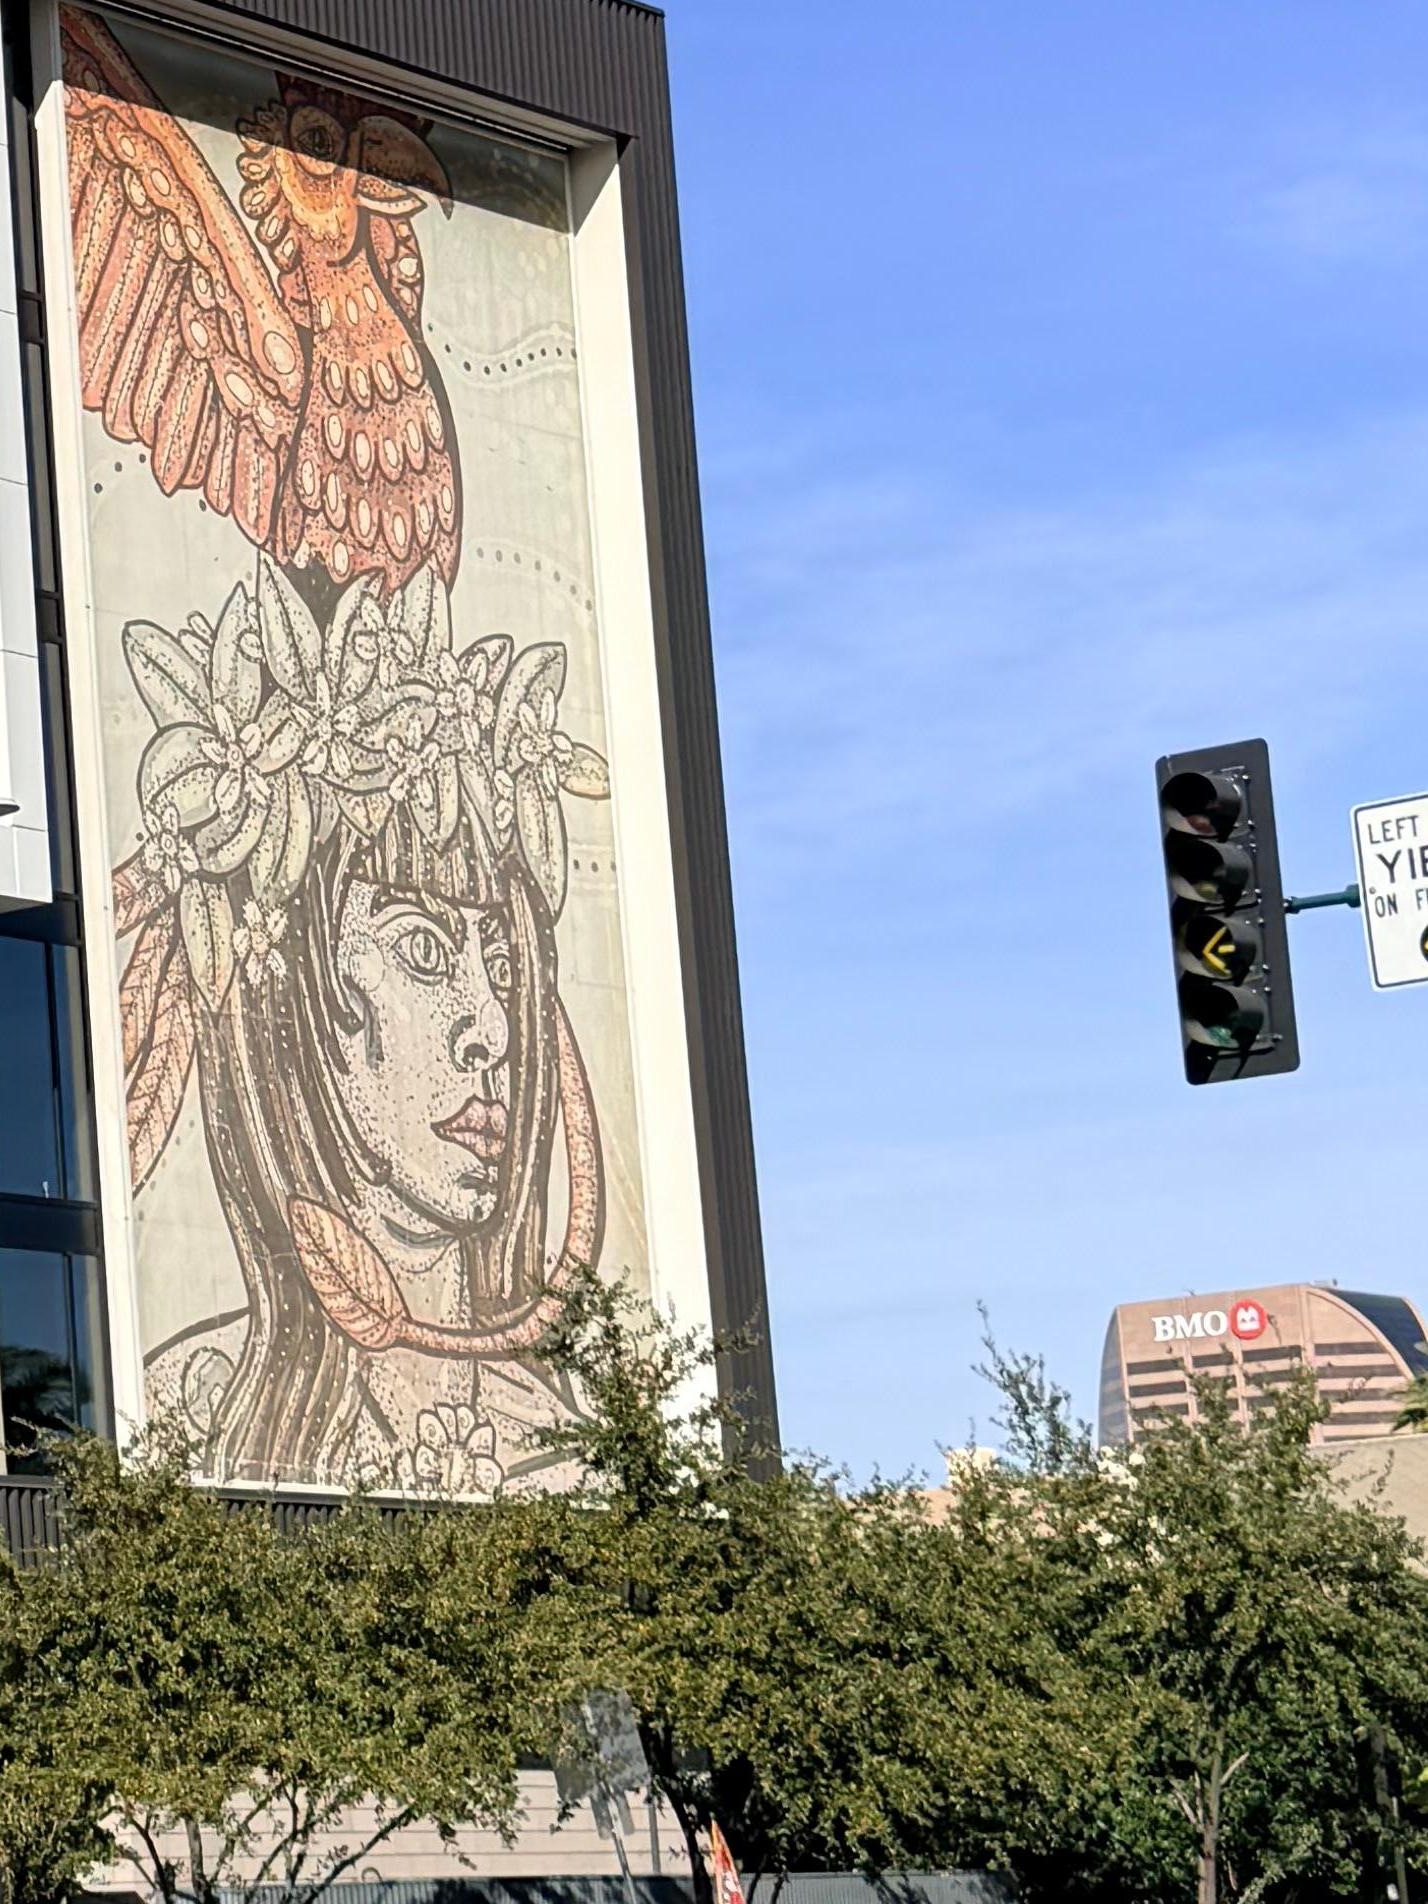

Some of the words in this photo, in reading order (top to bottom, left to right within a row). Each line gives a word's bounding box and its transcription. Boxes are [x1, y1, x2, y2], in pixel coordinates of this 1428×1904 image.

[1367, 815, 1419, 845] LEFT
[1374, 893, 1398, 919] ON
[1151, 1310, 1228, 1343] BMO
